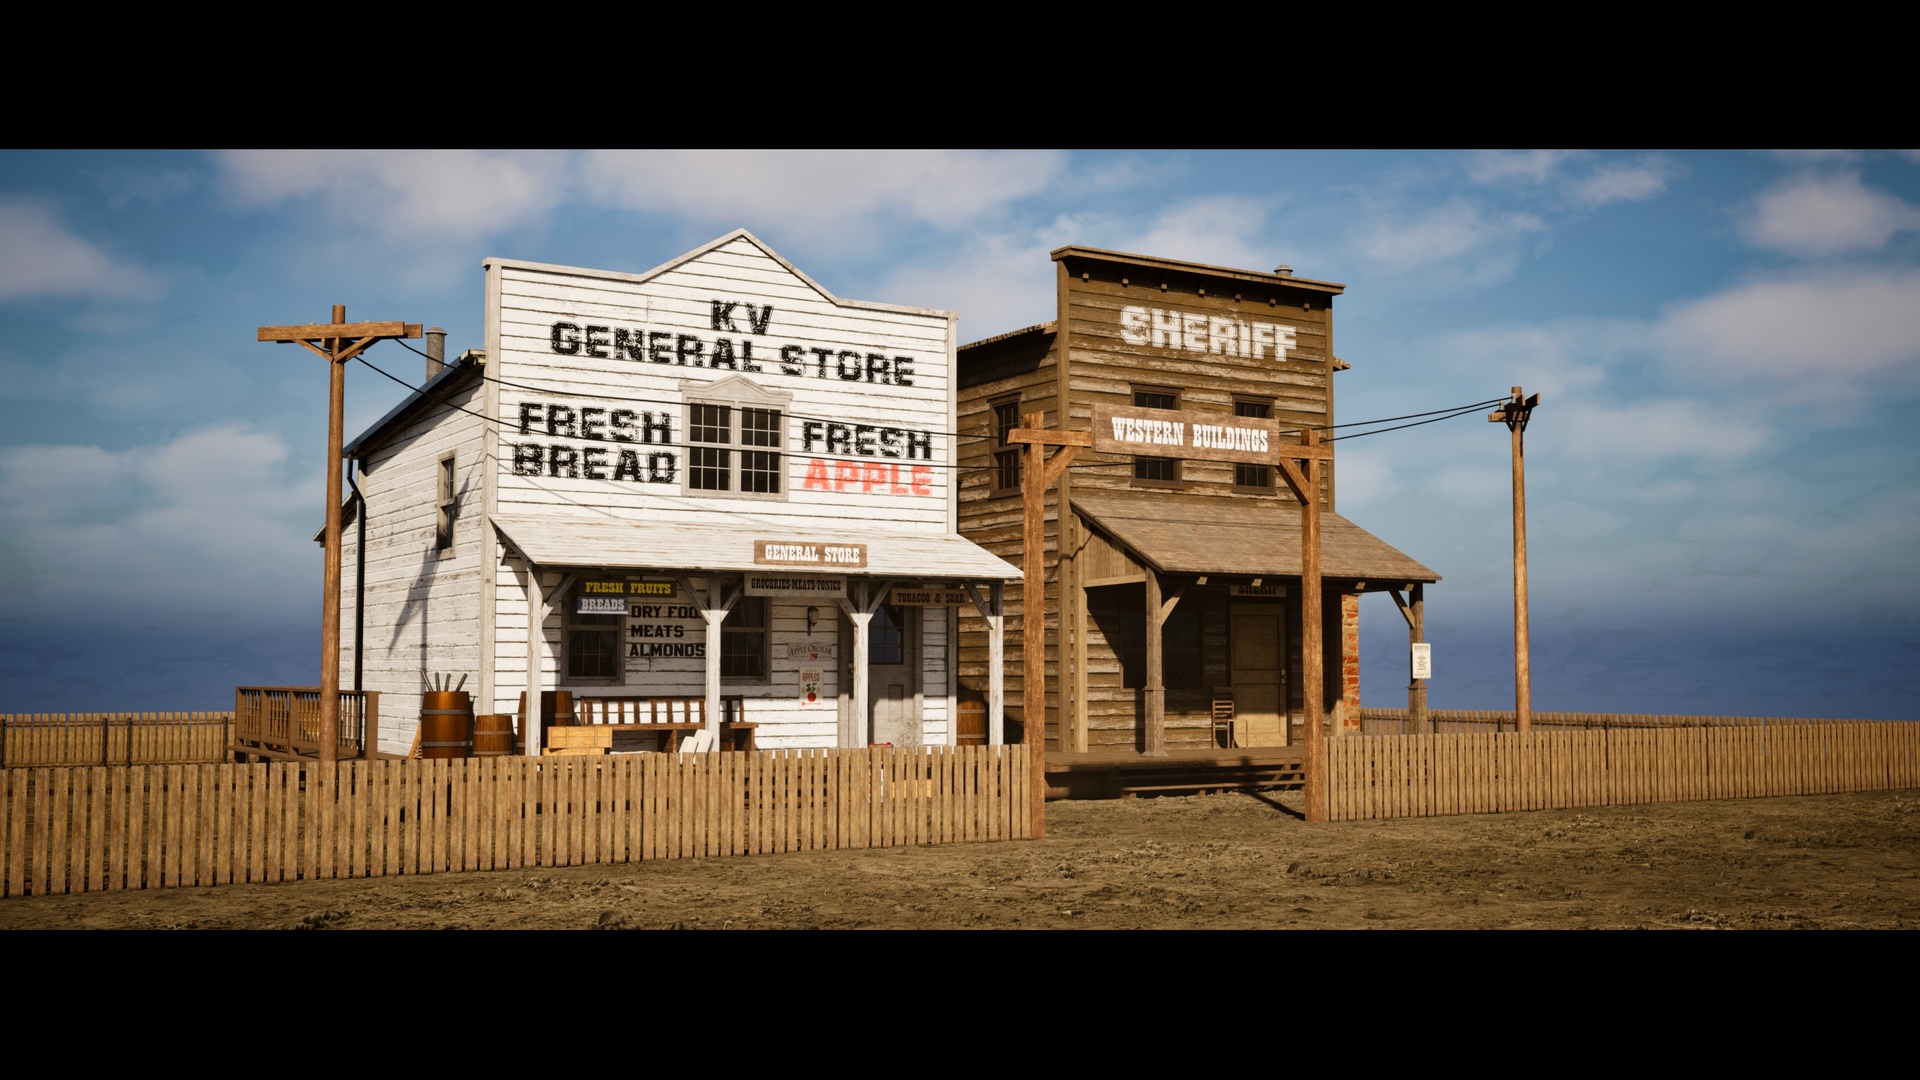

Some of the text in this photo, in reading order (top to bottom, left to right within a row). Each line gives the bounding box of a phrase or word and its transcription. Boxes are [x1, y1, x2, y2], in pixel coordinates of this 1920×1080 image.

[711, 299, 773, 335] KV
[1120, 305, 1297, 361] SHERIFF
[550, 321, 915, 387] GENERAL STORE
[518, 402, 671, 444] FRESH
[802, 421, 932, 461] FRESH
[1111, 416, 1269, 453] WESTERN BUILDINGS
[512, 442, 677, 484] BREAD
[803, 459, 933, 496] APPLE
[765, 544, 860, 563] GENERAL STORE
[585, 582, 671, 594] FRESH FRUITS
[897, 592, 930, 603] TOBACCO
[935, 593, 942, 603] &
[581, 599, 625, 611] BREADS
[631, 605, 702, 619] DRY FOO
[630, 625, 684, 637] MEATS
[629, 643, 705, 657] ALMONDS
[789, 645, 807, 657] APPLE
[802, 672, 820, 682] APPLES
